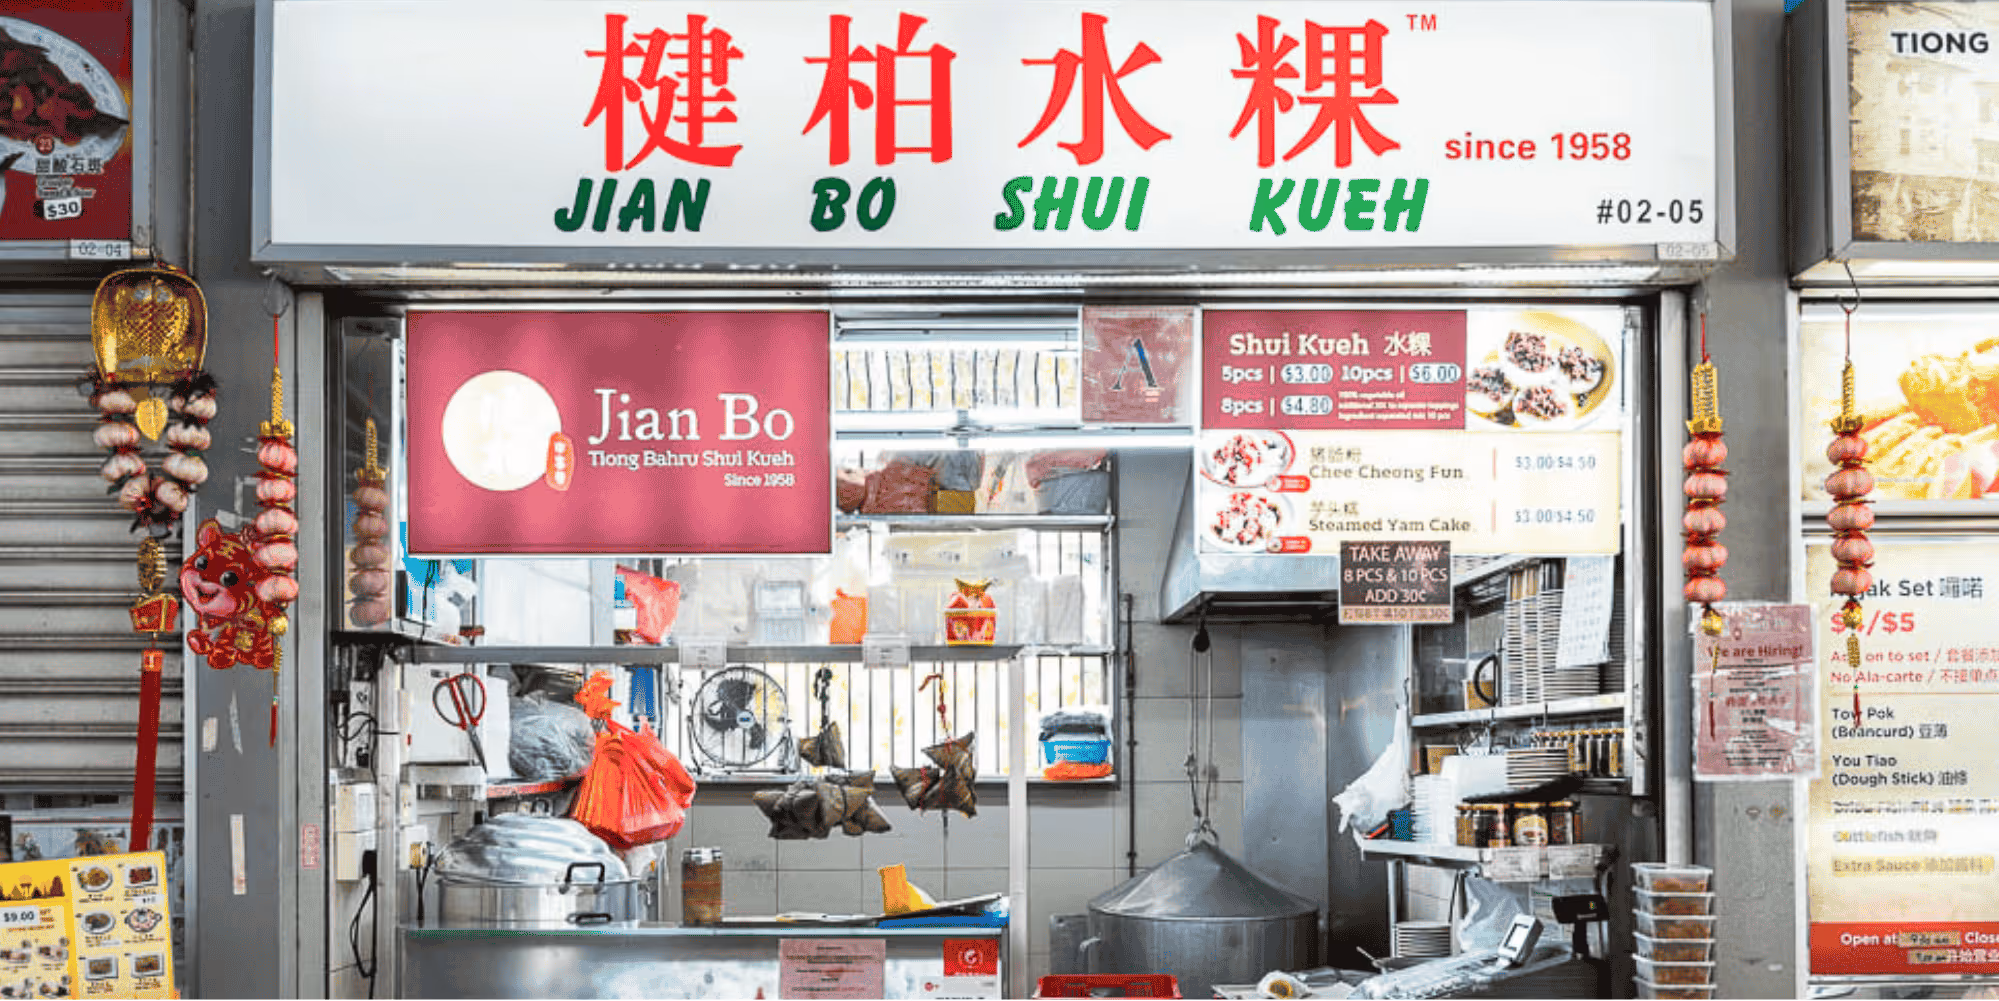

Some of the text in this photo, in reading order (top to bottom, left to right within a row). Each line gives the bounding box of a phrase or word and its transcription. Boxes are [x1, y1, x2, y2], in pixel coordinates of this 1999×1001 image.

[1406, 14, 1437, 31] TM
[1890, 32, 1989, 53] TIONG
[1445, 131, 1631, 160] since 1958
[47, 201, 78, 218] $30
[554, 176, 1429, 236] JIAN BO SHUI KUEH
[1596, 198, 1704, 225] #02-05
[1229, 332, 1291, 356] Shui
[1297, 332, 1370, 356] Kueh
[1221, 365, 1458, 385] 5pcs $3.00 10pcs $6.00
[1221, 397, 1264, 417] 8pcs
[1284, 397, 1330, 414] $4.80
[588, 388, 795, 445] Jian Bo
[588, 450, 795, 471] Tiong Bahru Shui Kueh
[724, 473, 796, 487] Since 1958
[1309, 465, 1464, 482] Chee Cheong Fun
[1309, 518, 1471, 531] Steamed Yam Cake
[1349, 545, 1442, 562] TAKE AWAY
[1344, 567, 1448, 582] 8 PCS & 10 PCS
[1365, 589, 1398, 603] ADD
[1898, 580, 1933, 597] Set
[1733, 647, 1755, 658] are
[1865, 652, 1884, 662] on
[1888, 651, 1904, 662] to
[1909, 650, 1929, 662] set
[1830, 671, 1851, 682] No
[1855, 670, 1924, 683] Ala-carte
[1867, 707, 1895, 720] Pok
[1832, 725, 1914, 740] (Beancurd)
[1832, 754, 1898, 767] You Tiao
[1832, 771, 1887, 788] (Dough
[1891, 771, 1935, 788] Stick)
[1834, 860, 1872, 873] Extra
[1875, 858, 1921, 873] Sauce
[1840, 932, 1880, 947] Open
